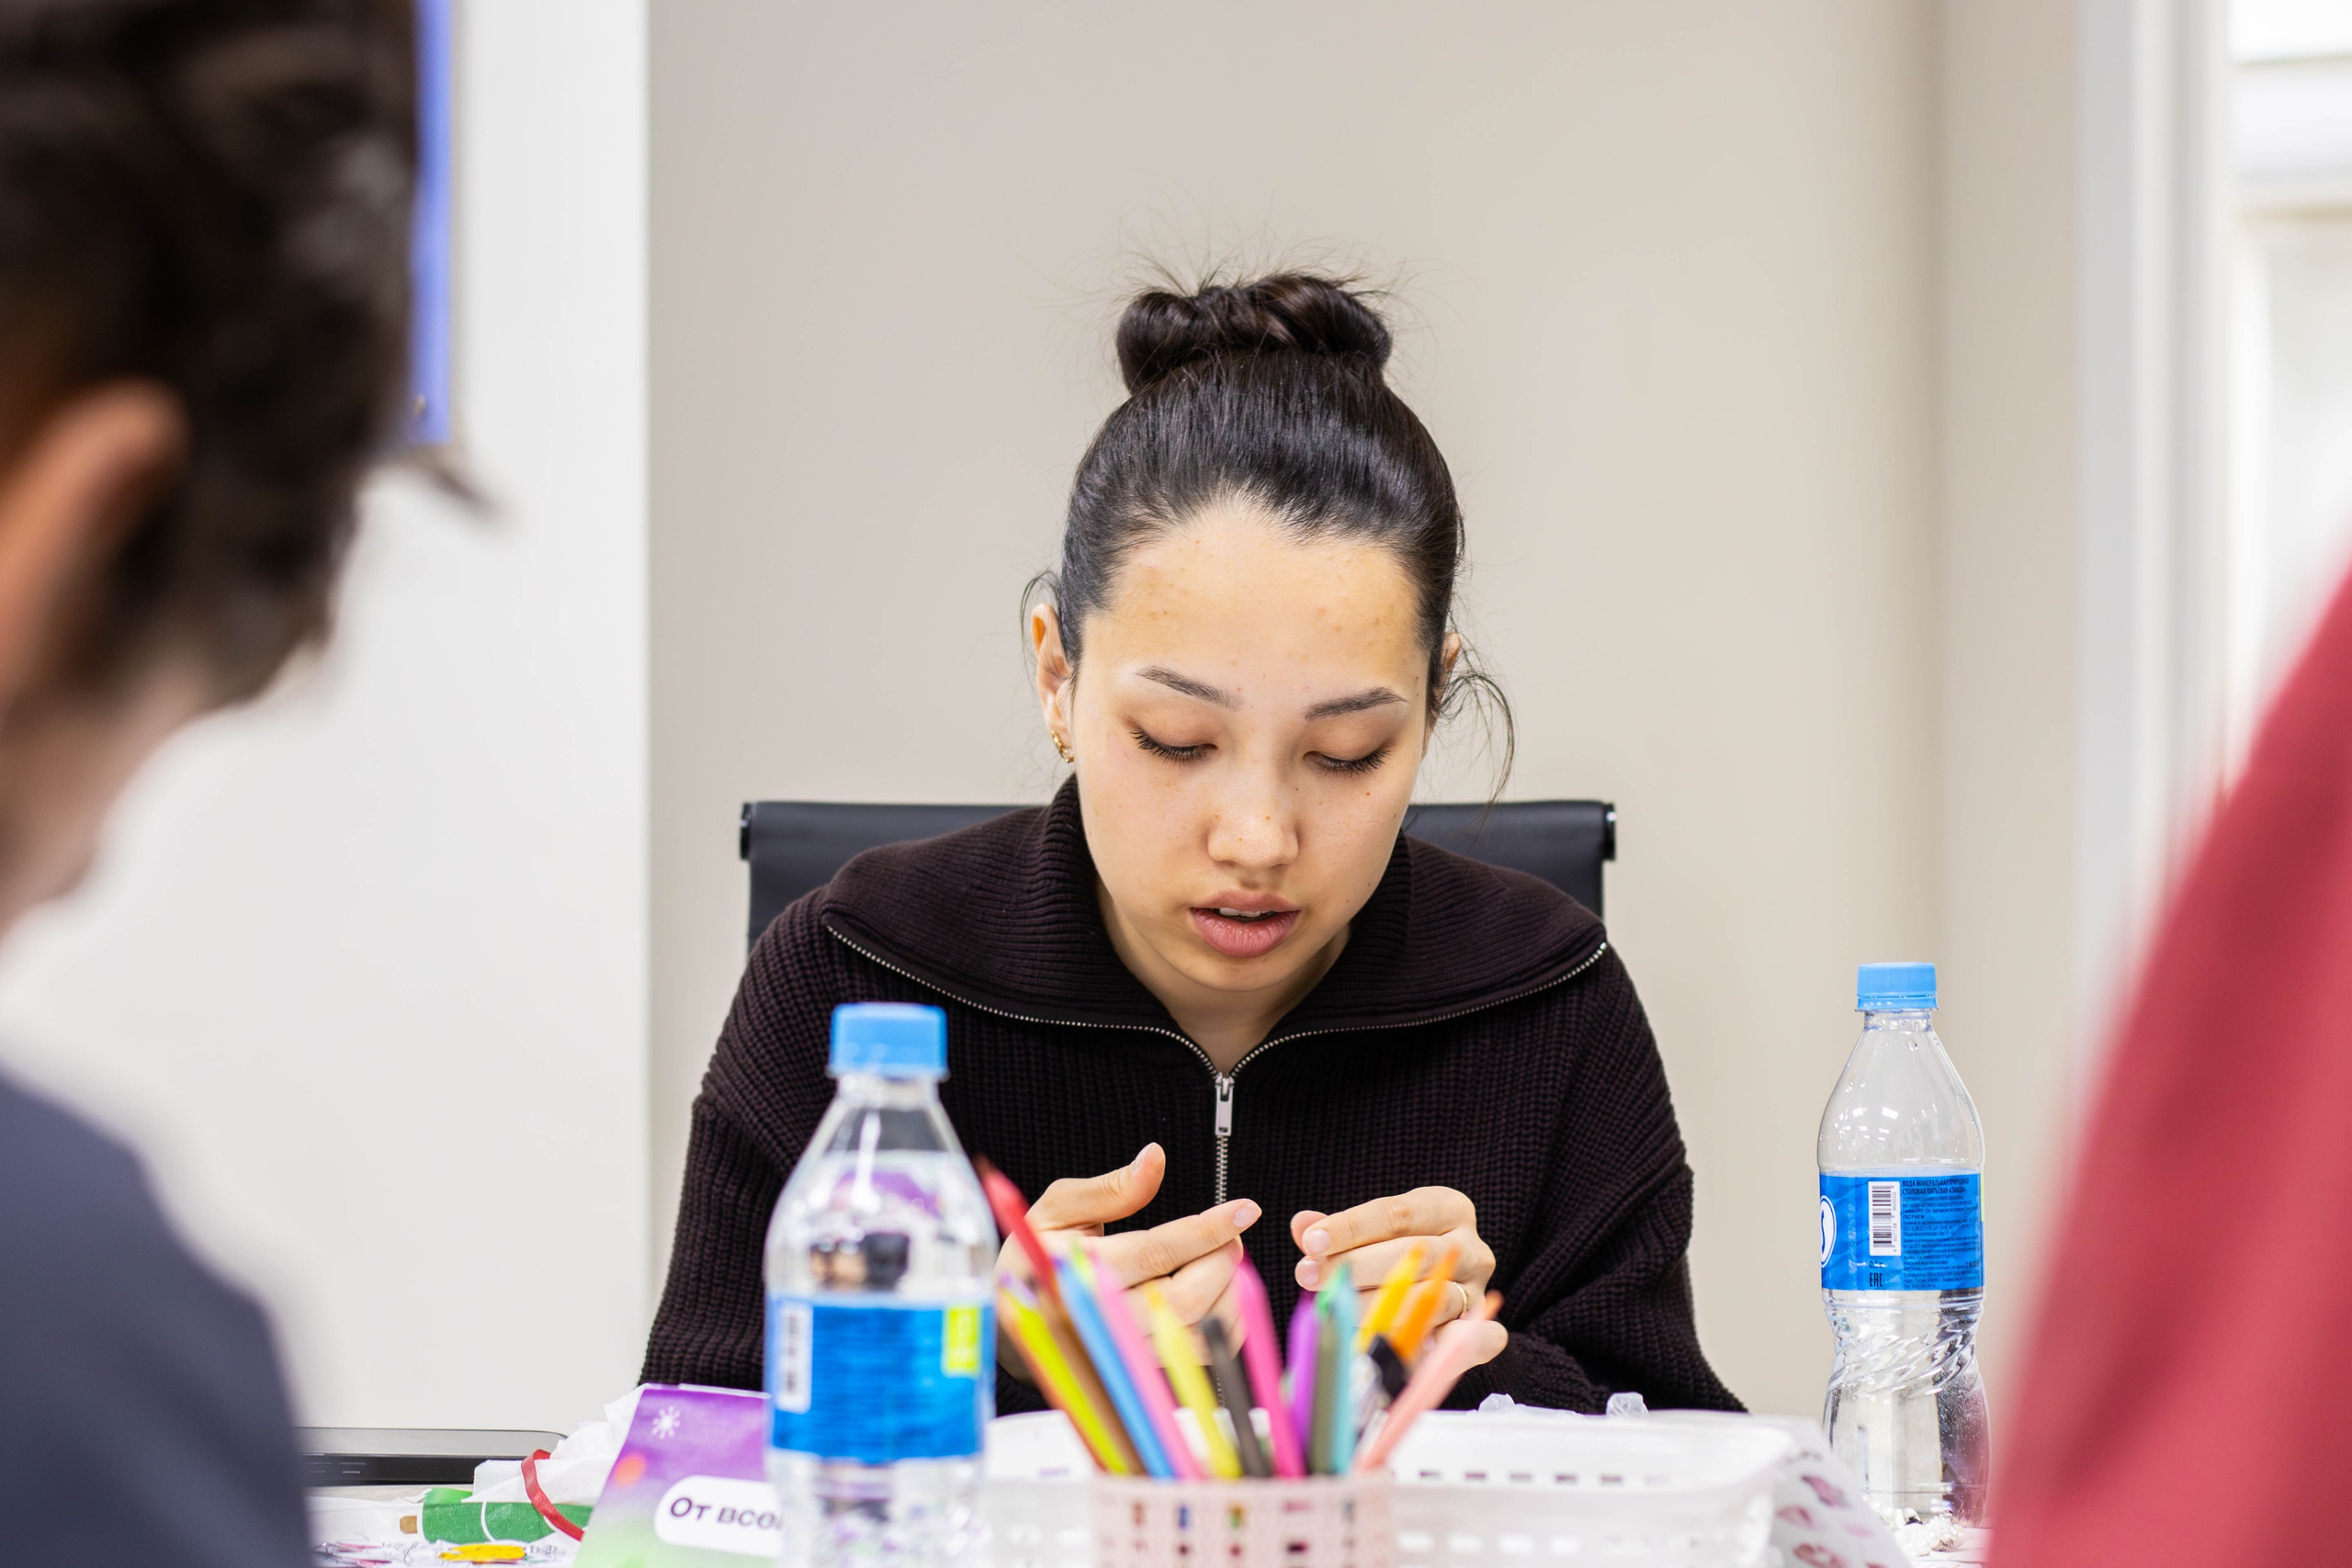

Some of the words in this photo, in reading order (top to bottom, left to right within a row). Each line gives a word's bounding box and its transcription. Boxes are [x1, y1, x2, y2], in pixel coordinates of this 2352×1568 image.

[1903, 1179, 1916, 1188] ВОДА
[1917, 1179, 1949, 1187] МИНЕРАЛЬНАЯ
[1870, 1273, 1883, 1287] EAC
[670, 1496, 712, 1521] От
